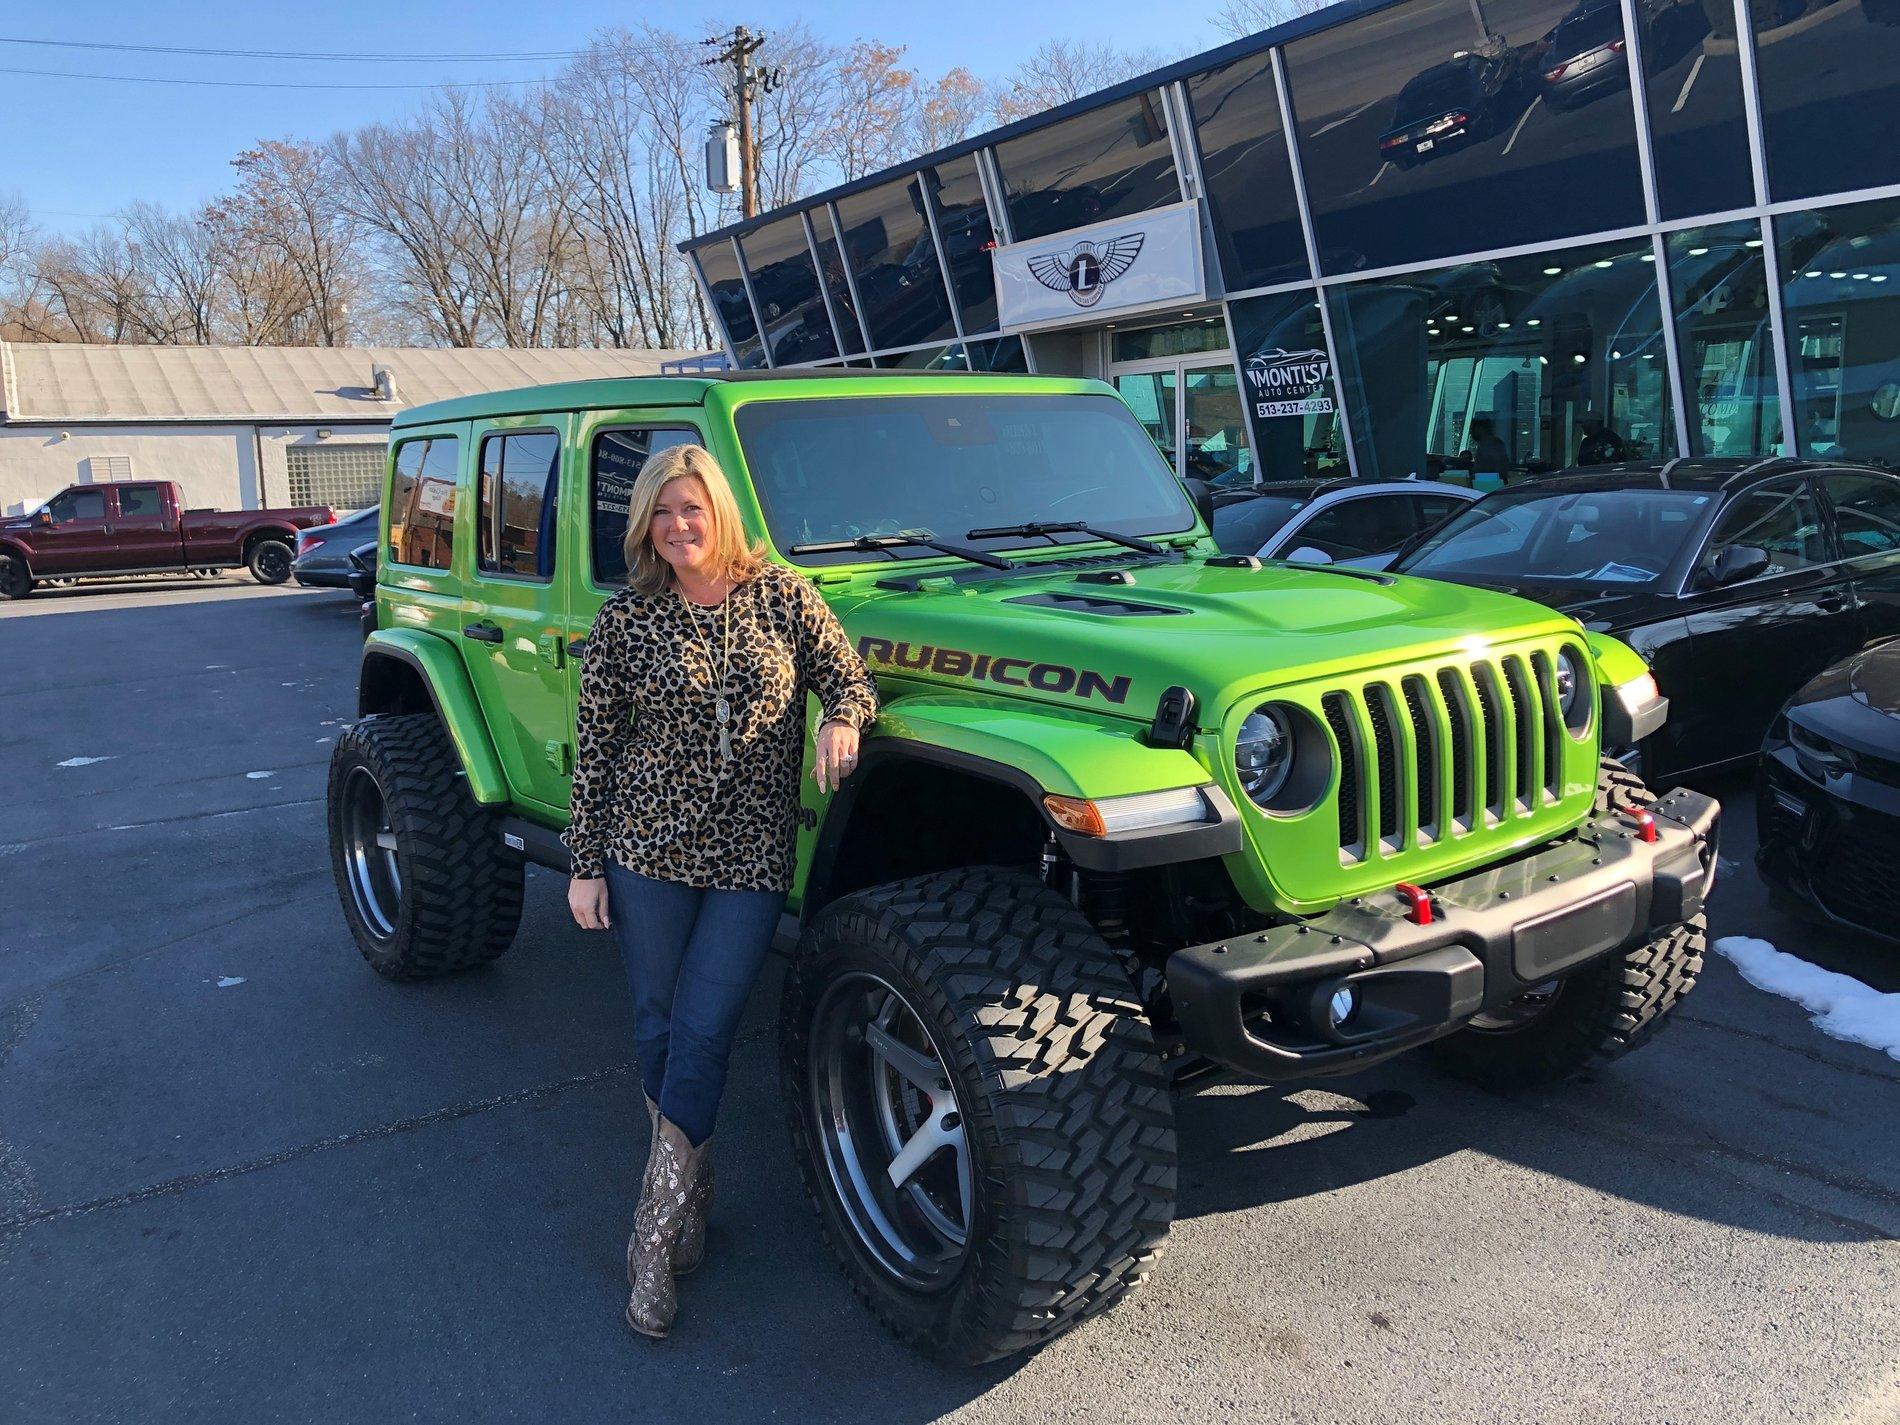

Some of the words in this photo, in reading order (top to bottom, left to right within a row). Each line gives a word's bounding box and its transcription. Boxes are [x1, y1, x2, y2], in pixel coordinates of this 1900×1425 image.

[1078, 260, 1094, 290] L
[1255, 363, 1321, 388] MONTI'S
[1258, 387, 1281, 398] AUTO
[1286, 384, 1325, 395] CENTER
[1259, 400, 1331, 416] 513-237-4293
[857, 636, 1133, 704] RUBICON
